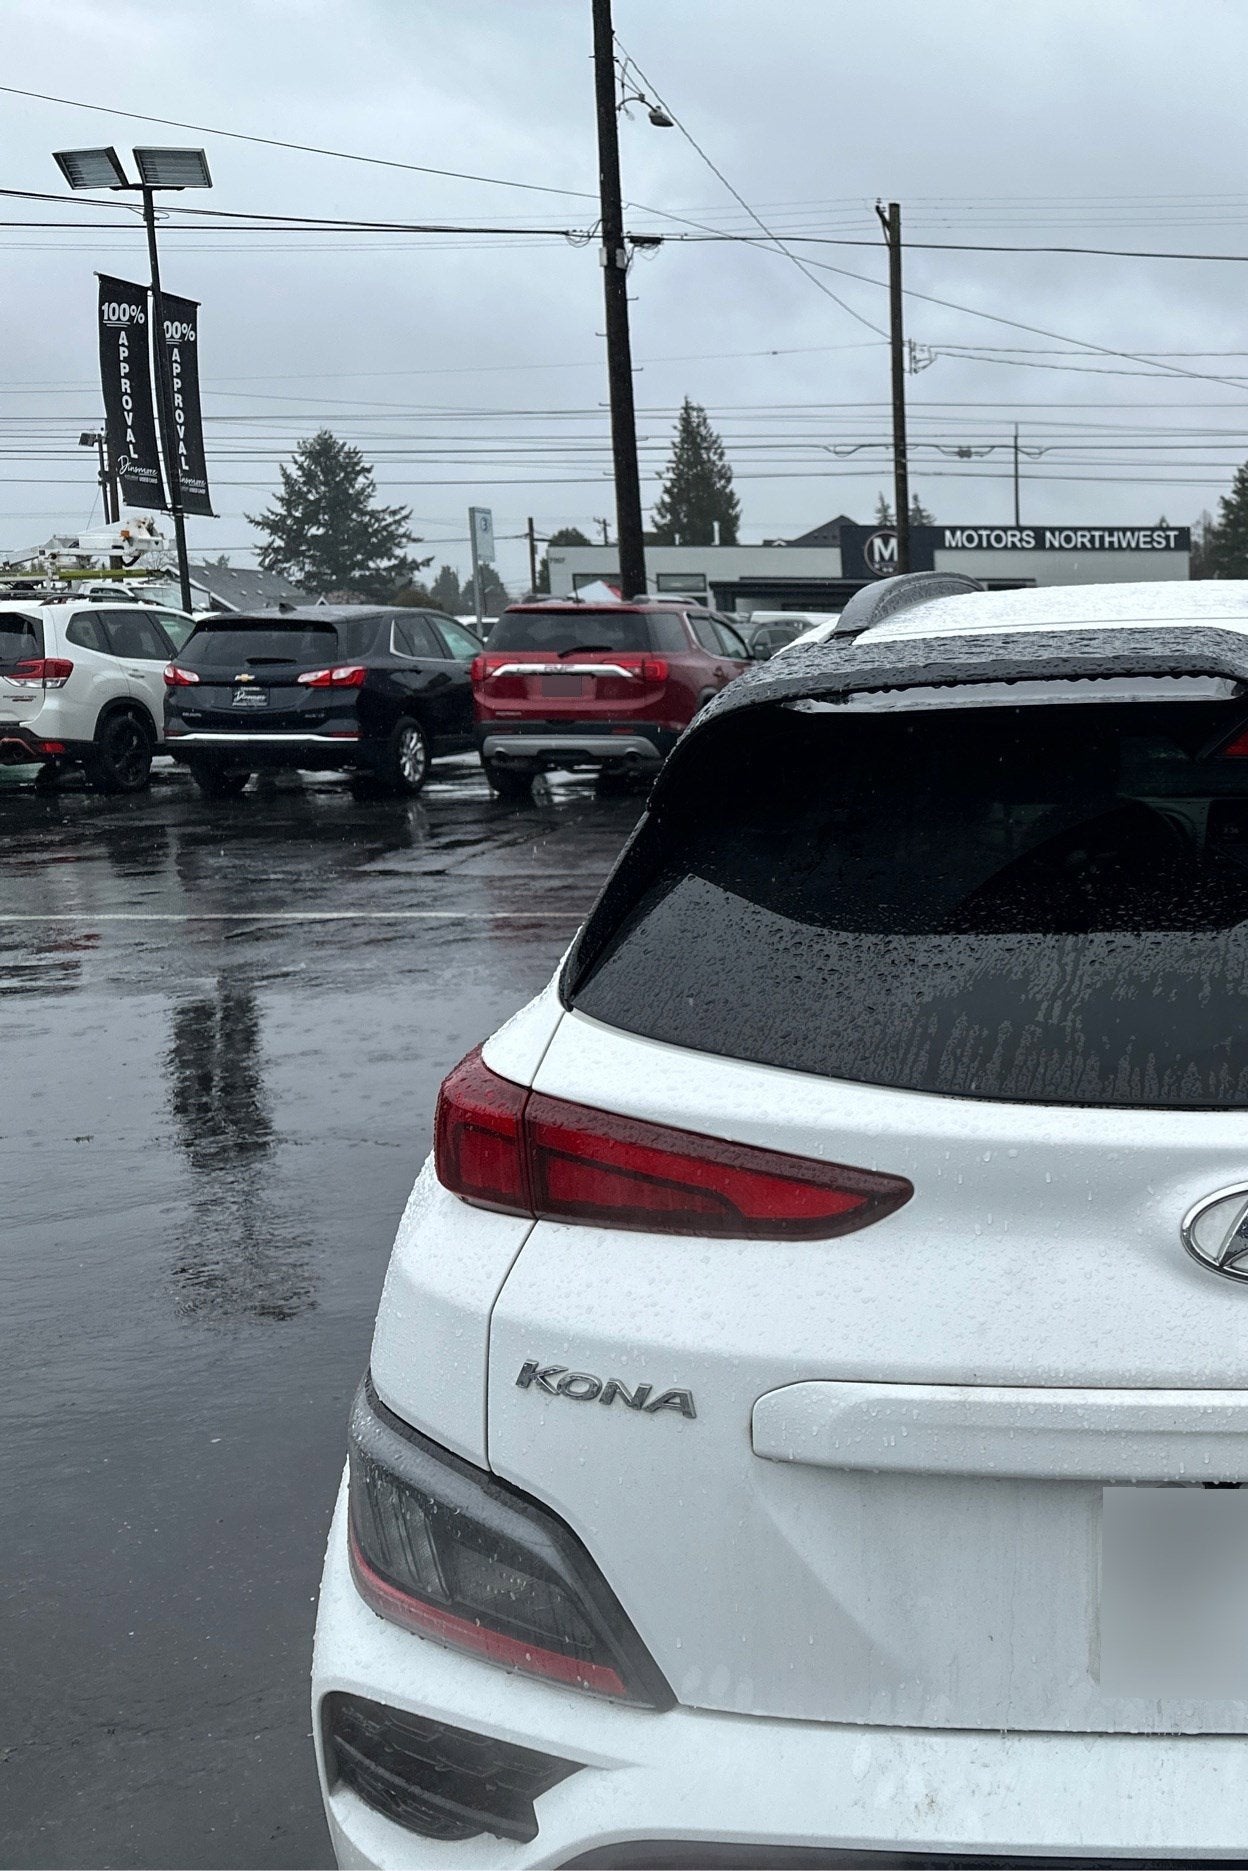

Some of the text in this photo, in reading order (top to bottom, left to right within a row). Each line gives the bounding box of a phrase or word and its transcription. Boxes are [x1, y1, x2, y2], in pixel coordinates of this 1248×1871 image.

[101, 302, 145, 324] 100%
[163, 320, 196, 341] 00%
[118, 331, 139, 459] APPROVAL
[172, 348, 190, 470] APPROVAL
[873, 537, 898, 562] M
[944, 529, 1179, 549] MOTORS NORTHWEST
[515, 1358, 697, 1419] KONA
